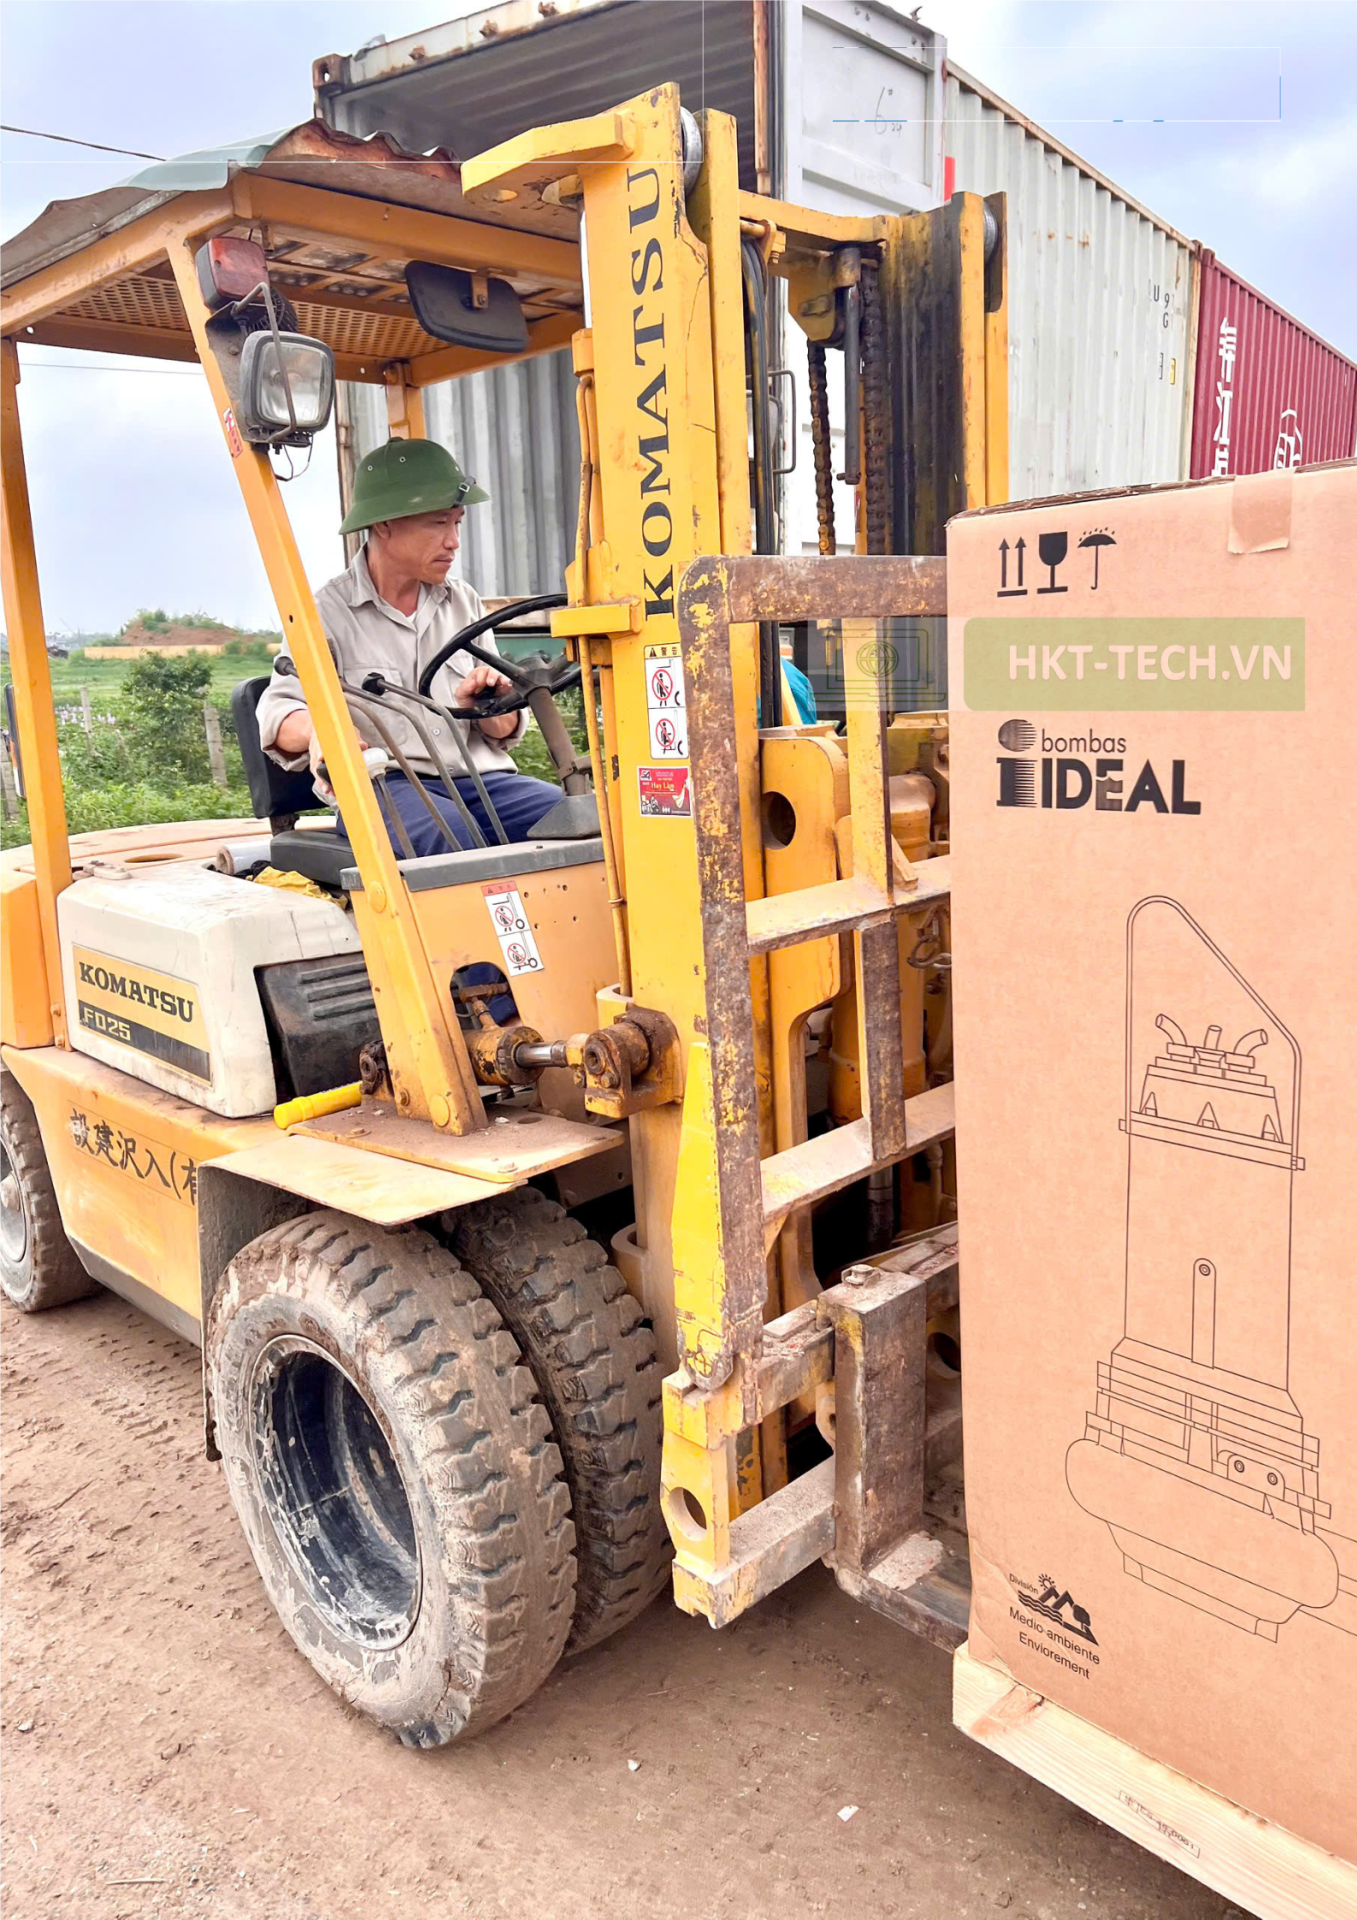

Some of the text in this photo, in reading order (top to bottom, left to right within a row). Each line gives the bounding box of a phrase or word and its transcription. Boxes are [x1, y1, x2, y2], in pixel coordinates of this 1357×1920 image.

[626, 167, 676, 621] KOMATSU
[1041, 728, 1127, 753] bombas
[1041, 757, 1202, 815] IDEAL
[79, 961, 194, 1024] KOMATSU
[1009, 1606, 1100, 1665] Medio ambiente
[1019, 1630, 1090, 1680] Enviorement
